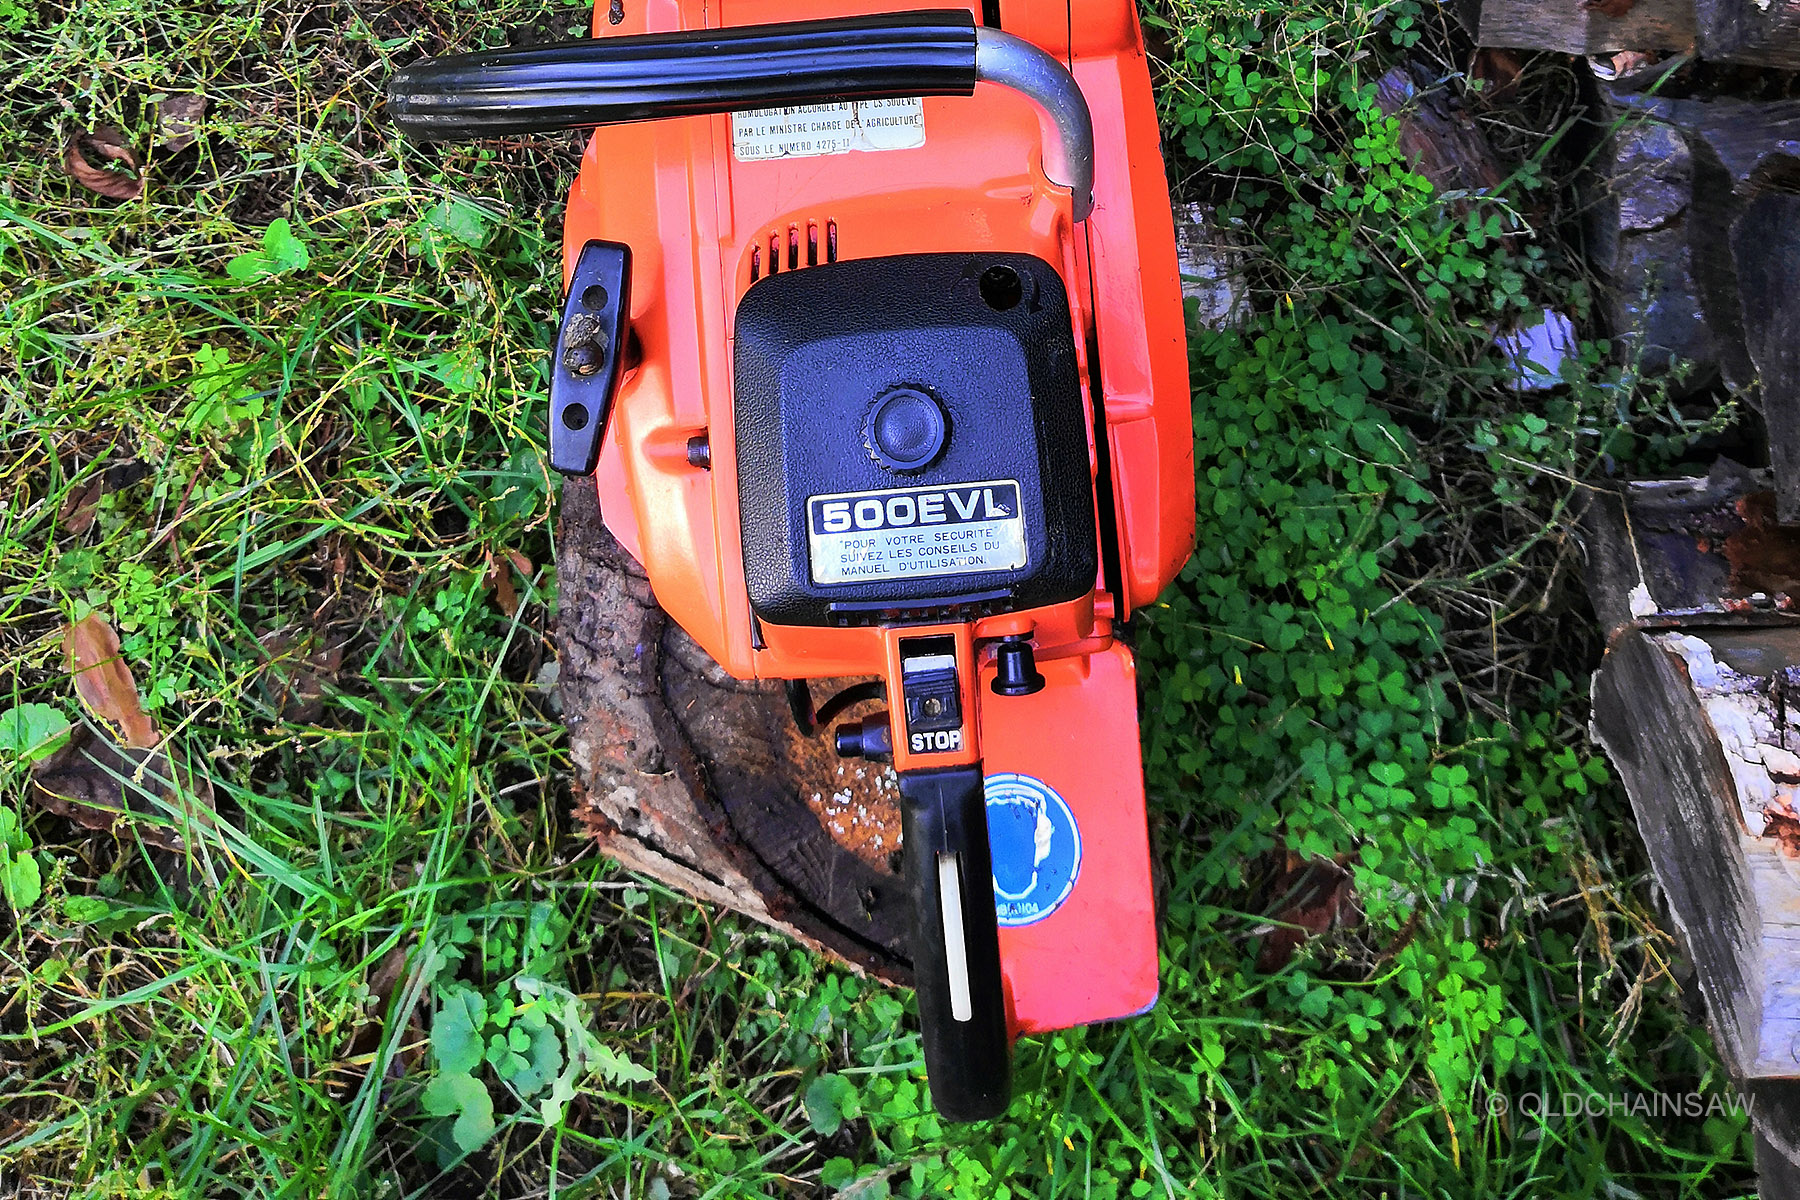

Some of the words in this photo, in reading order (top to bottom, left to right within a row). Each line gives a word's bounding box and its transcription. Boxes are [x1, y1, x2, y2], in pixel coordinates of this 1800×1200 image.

[738, 127, 754, 138] PAR
[756, 125, 767, 136] LE
[769, 121, 807, 135] MINISTRE
[811, 118, 842, 132] CHARGE
[845, 117, 856, 129] DE
[739, 144, 760, 156] SOUS
[764, 142, 774, 154] LE
[778, 139, 812, 153] NUMERO
[823, 488, 1011, 532] 500EVL
[885, 535, 925, 546] VOTRE
[840, 551, 883, 563] SUIVEZ
[889, 548, 912, 559] LES
[918, 543, 978, 557] CONSEILS
[984, 541, 1000, 551] DU
[841, 564, 890, 576] MANUEL
[898, 555, 987, 571] D'UTILISATION.
[911, 730, 961, 751] STOP
